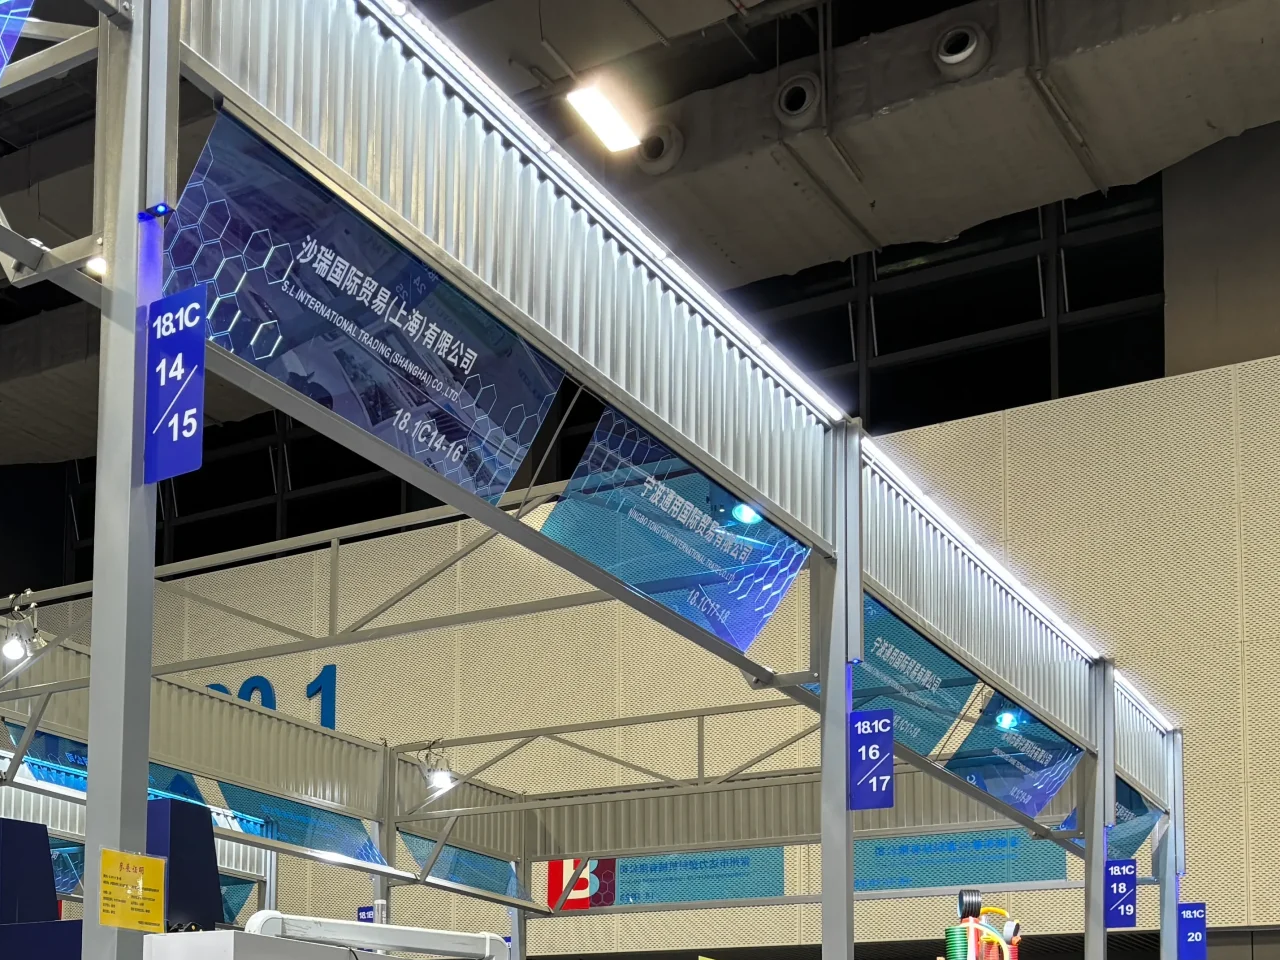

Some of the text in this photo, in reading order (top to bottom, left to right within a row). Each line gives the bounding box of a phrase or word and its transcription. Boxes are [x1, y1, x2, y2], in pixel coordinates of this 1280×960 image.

[296, 234, 478, 375] 沙瑞国际贸易(上海)有限公司
[151, 302, 201, 340] 18.1C
[295, 288, 357, 338] INTERNATIONAL
[357, 329, 391, 358] TRADING
[389, 351, 433, 386] (SHANGHAI)
[155, 352, 185, 387] 14
[167, 407, 198, 442] 15
[392, 408, 463, 463] 18.1C14-16
[628, 507, 648, 526] NINGBO
[641, 475, 753, 564] 宁波通用国际贸易有限公司
[687, 588, 730, 624] 18.1C17-18
[854, 719, 891, 735] 18.1C
[858, 744, 880, 761] 16
[869, 775, 891, 792] 17
[1108, 865, 1135, 876] 18.1C
[1111, 883, 1127, 894] 18
[1118, 905, 1134, 916] 19
[1181, 909, 1205, 919] 18.1C
[1188, 931, 1203, 942] 20
